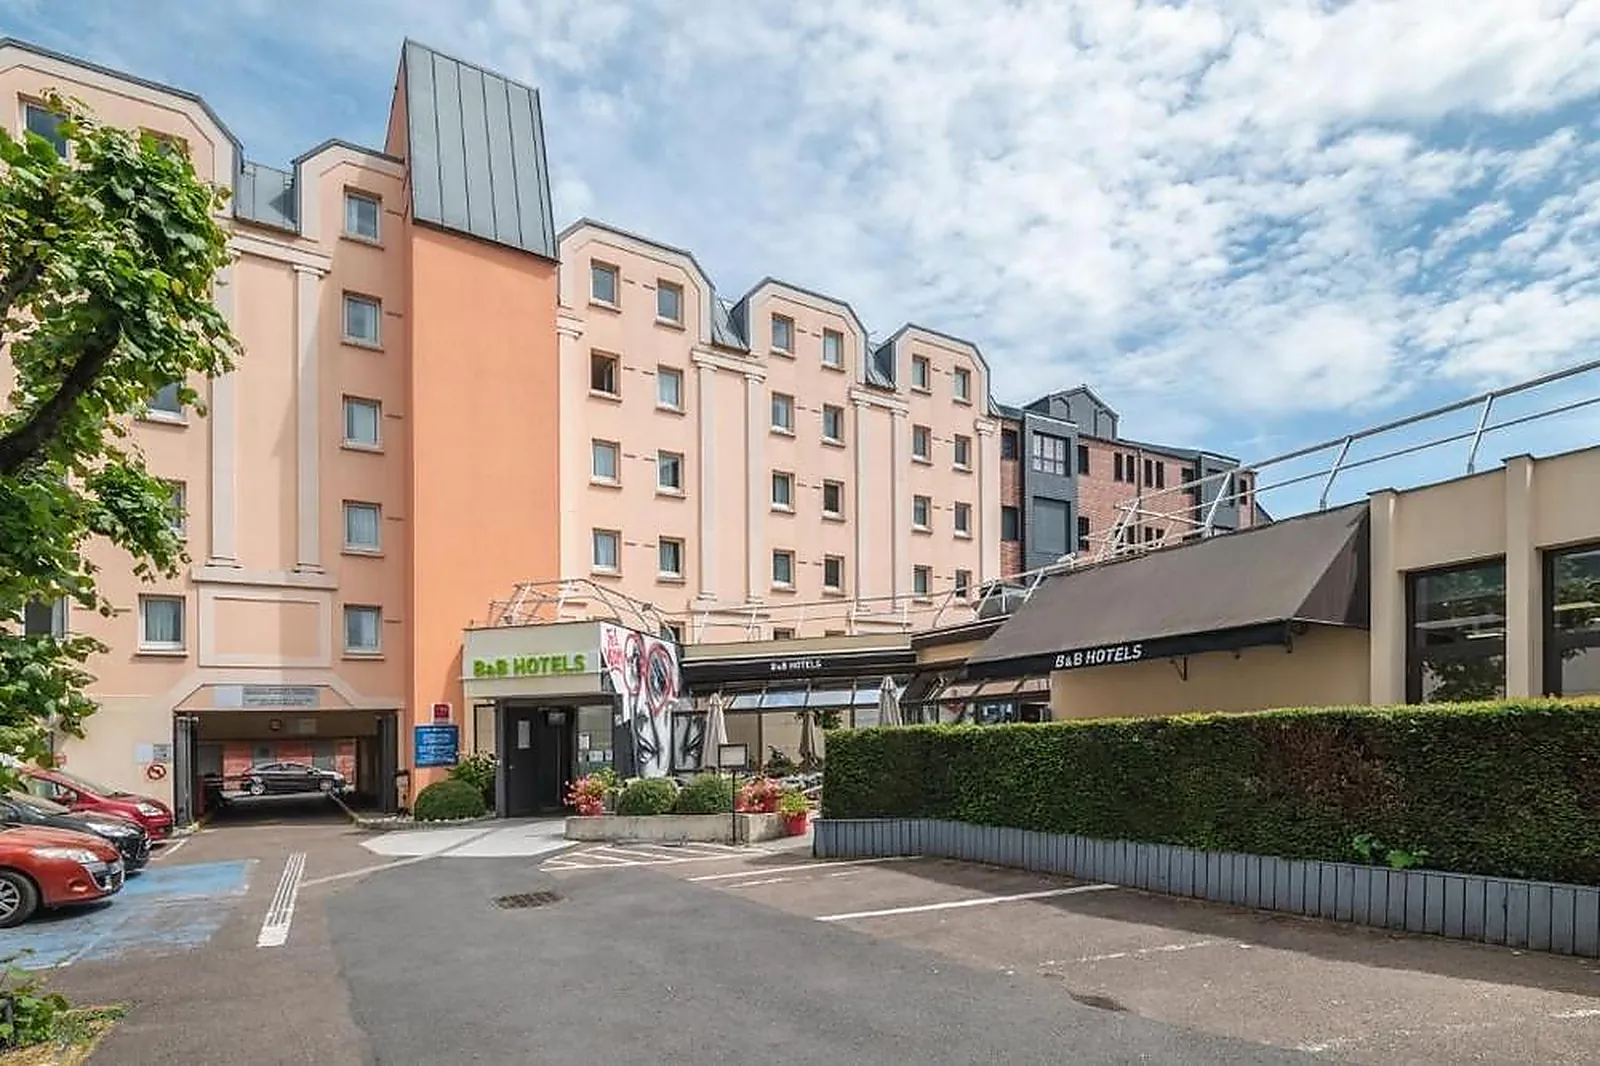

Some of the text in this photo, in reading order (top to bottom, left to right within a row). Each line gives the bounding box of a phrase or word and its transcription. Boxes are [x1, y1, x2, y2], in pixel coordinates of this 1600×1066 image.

[474, 654, 586, 678] B&B HOTELS
[789, 660, 822, 671] HOTELS
[1055, 644, 1142, 668] B&B HOTELS
